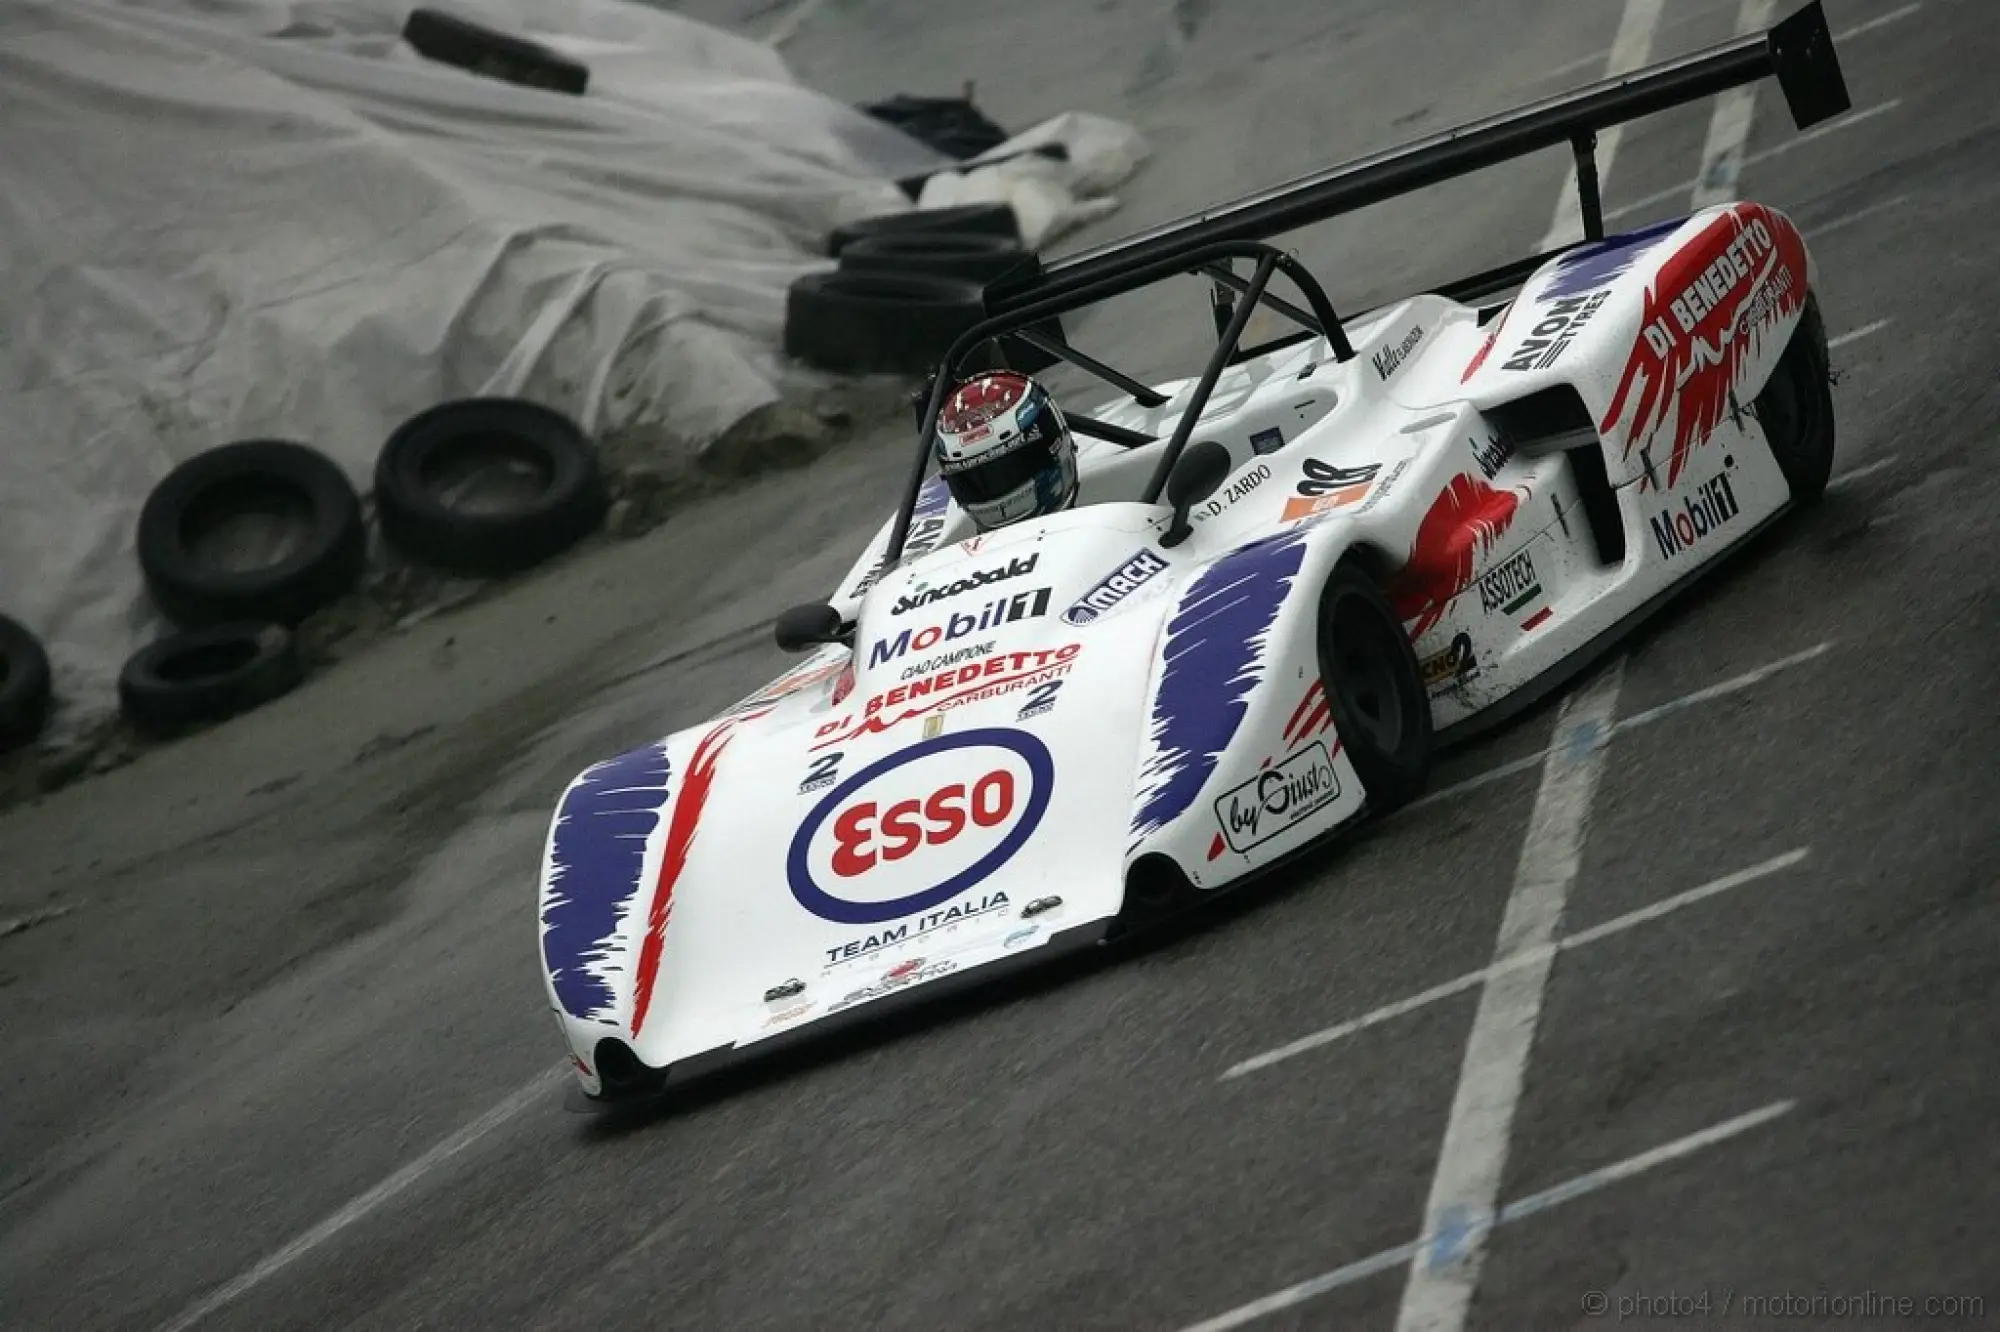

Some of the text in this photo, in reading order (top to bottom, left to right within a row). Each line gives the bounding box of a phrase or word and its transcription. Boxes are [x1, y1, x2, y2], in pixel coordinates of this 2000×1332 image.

[1643, 218, 1773, 360] DI BENEDETTO
[1501, 294, 1591, 370] AVON
[1206, 464, 1272, 517] D. ZARDO
[1479, 549, 1536, 616] ASSOTECH
[868, 597, 1008, 670] Mobil
[901, 640, 997, 681] CIAO CAMPIONE
[814, 643, 1082, 738] DI BENEDETTO
[937, 663, 1073, 713] CARBURANTI
[825, 924, 908, 962] TEAM
[918, 890, 1010, 931] ITALIA
